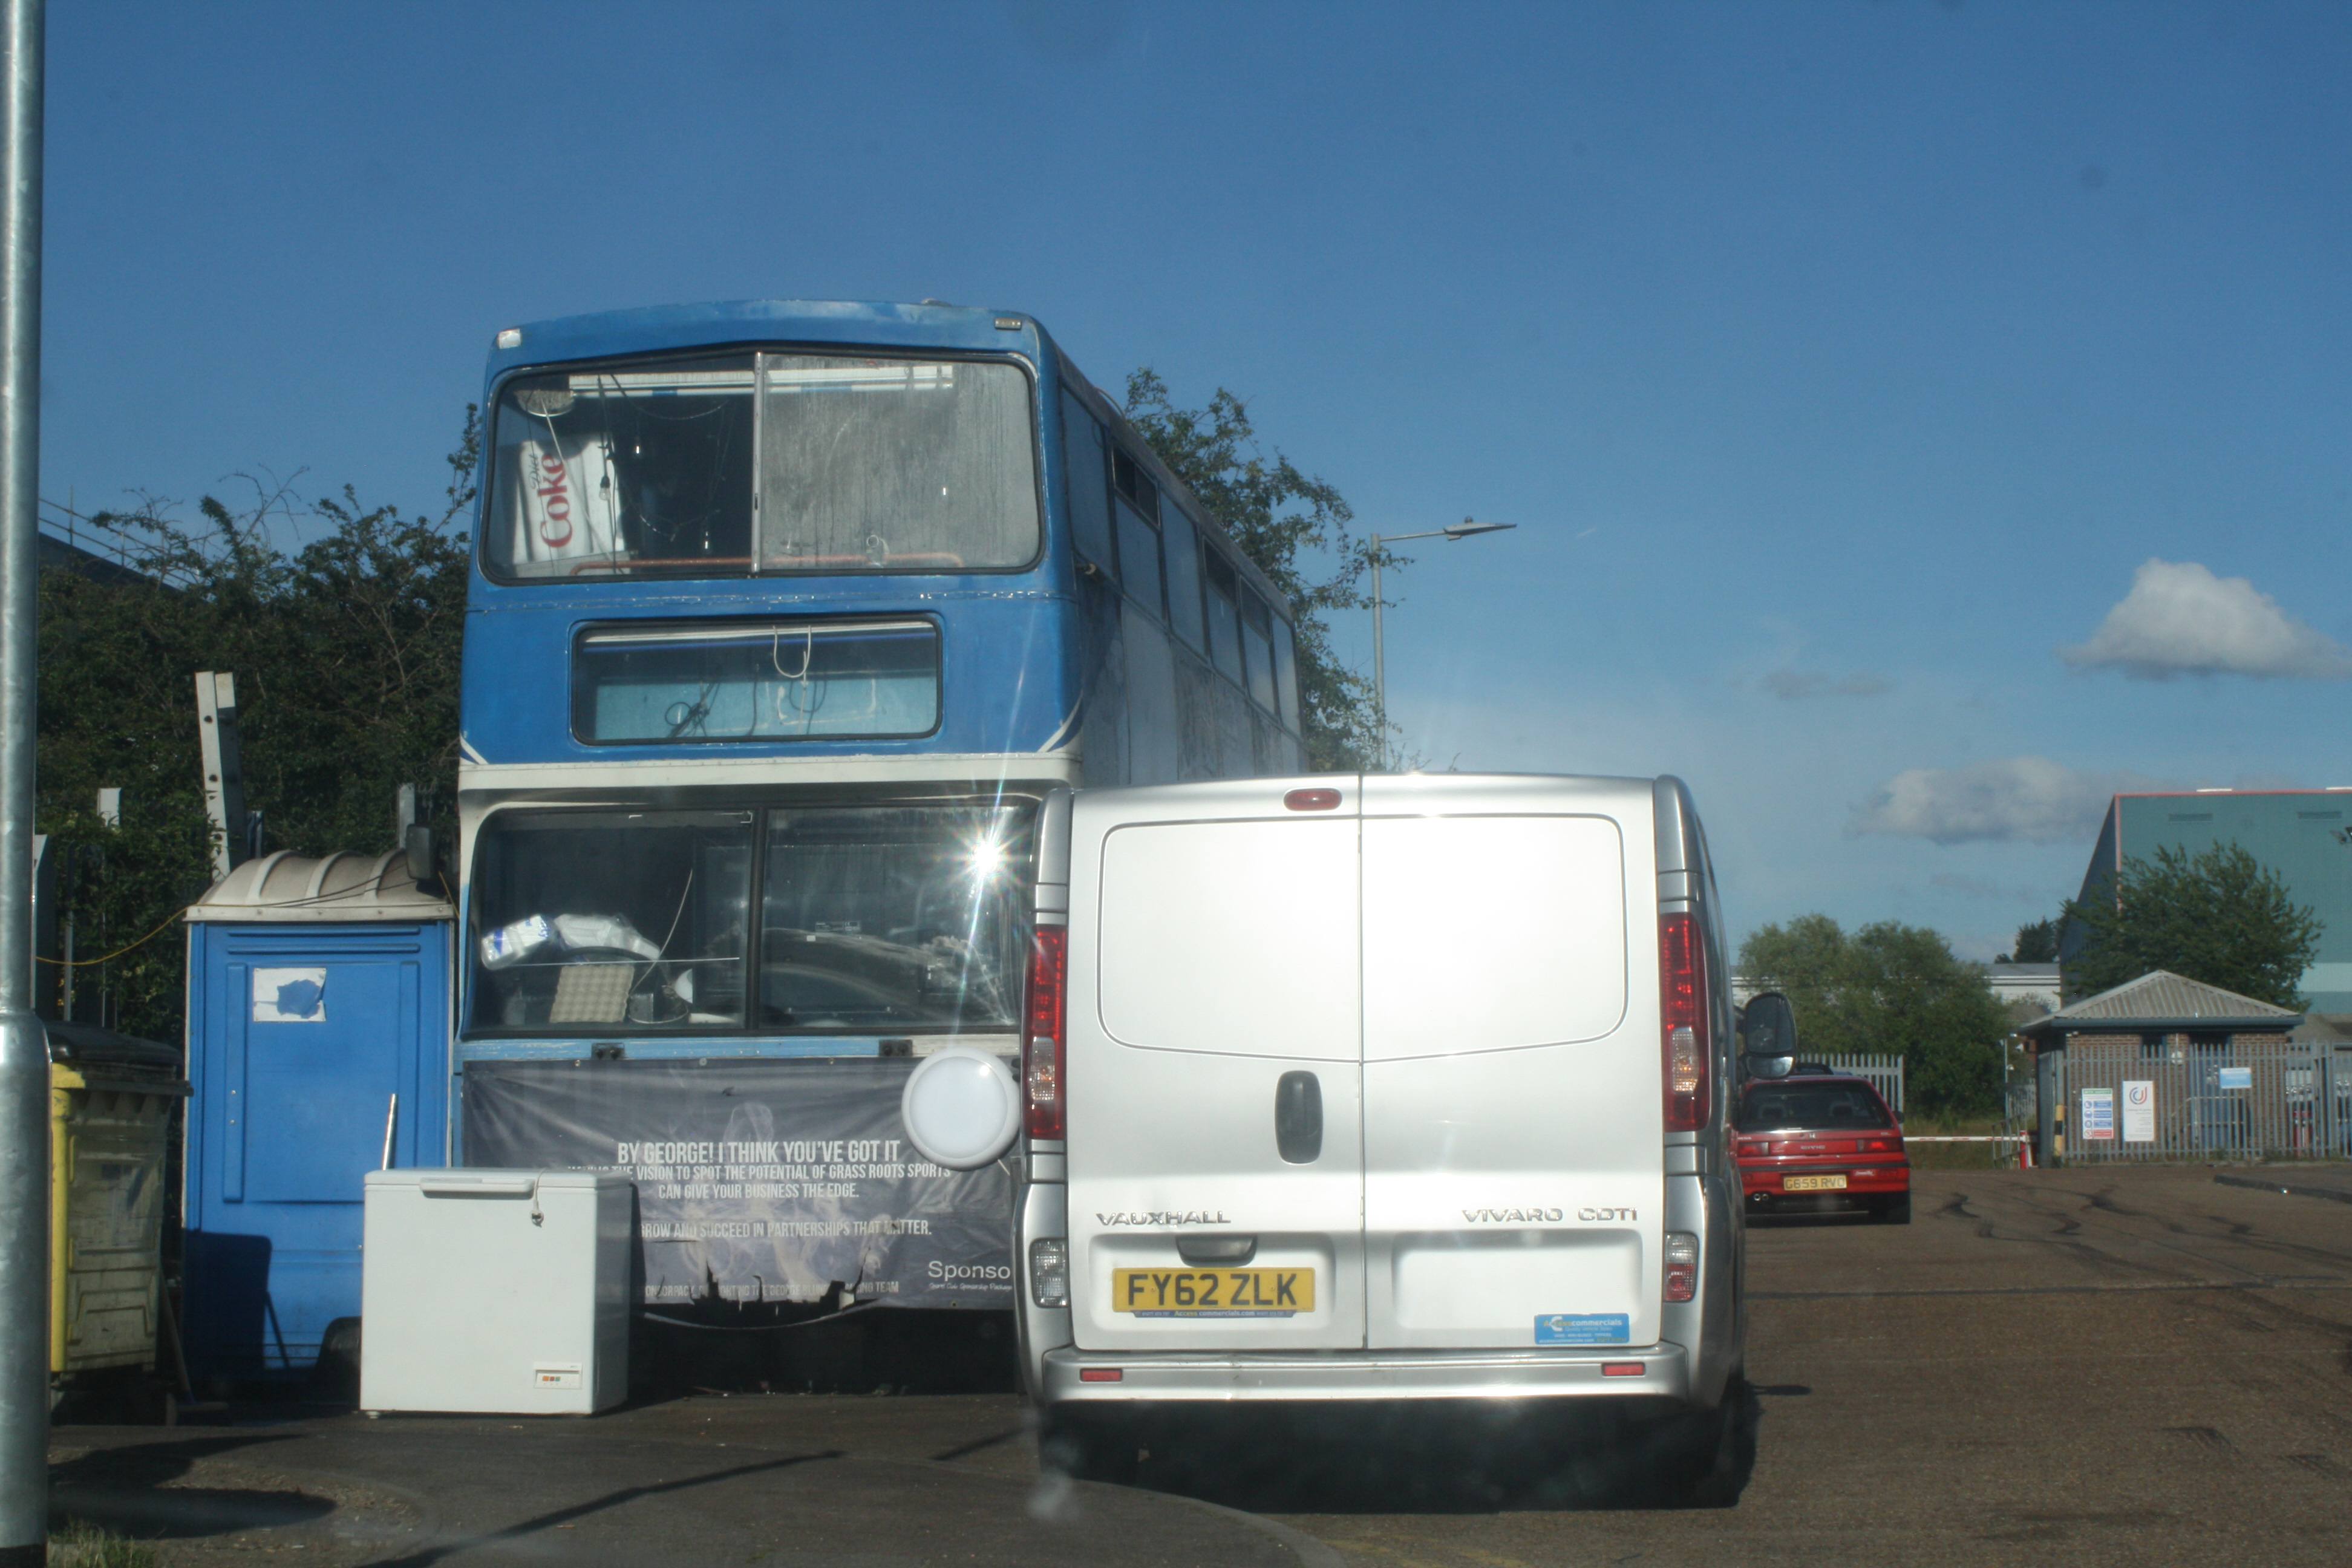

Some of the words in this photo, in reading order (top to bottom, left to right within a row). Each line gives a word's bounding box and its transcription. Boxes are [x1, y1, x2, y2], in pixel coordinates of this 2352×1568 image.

[538, 452, 573, 547] Coke
[618, 1143, 640, 1164] BY
[644, 1142, 713, 1164] GEORGE!
[719, 1142, 724, 1163] I
[727, 1141, 779, 1163] THINK
[783, 1140, 844, 1163] YOU'VE
[848, 1140, 881, 1162] GOT
[885, 1140, 901, 1161] IT
[637, 1166, 673, 1180] VISION
[676, 1166, 690, 1180] TO
[693, 1165, 722, 1180] SPOT
[724, 1165, 746, 1180] THE
[749, 1165, 810, 1180] POTENTIAL
[812, 1165, 826, 1179] OF
[829, 1164, 866, 1179] GRASS
[869, 1163, 905, 1178] ROOTS
[907, 1163, 951, 1178] SPORTS
[659, 1184, 681, 1199] CAN
[684, 1184, 710, 1199] GIVE
[713, 1184, 742, 1198] YOUR
[745, 1183, 799, 1198] BUSINESS
[802, 1183, 825, 1198] THE
[826, 1183, 860, 1197] EDGE.
[1785, 1178, 1817, 1189] G659
[1096, 1210, 1231, 1226] VAUXHALL
[1462, 1208, 1563, 1222] VIVARO
[673, 1223, 696, 1238] AND
[700, 1222, 750, 1237] SUCCEED
[753, 1222, 765, 1237] IN
[767, 1221, 849, 1237] PARTNERSHIPS
[854, 1221, 881, 1236] THAT
[884, 1220, 932, 1236] MATTER.
[875, 1281, 899, 1293] TEAM
[1128, 1273, 1218, 1305] FY62
[1230, 1273, 1297, 1305] ZLK
